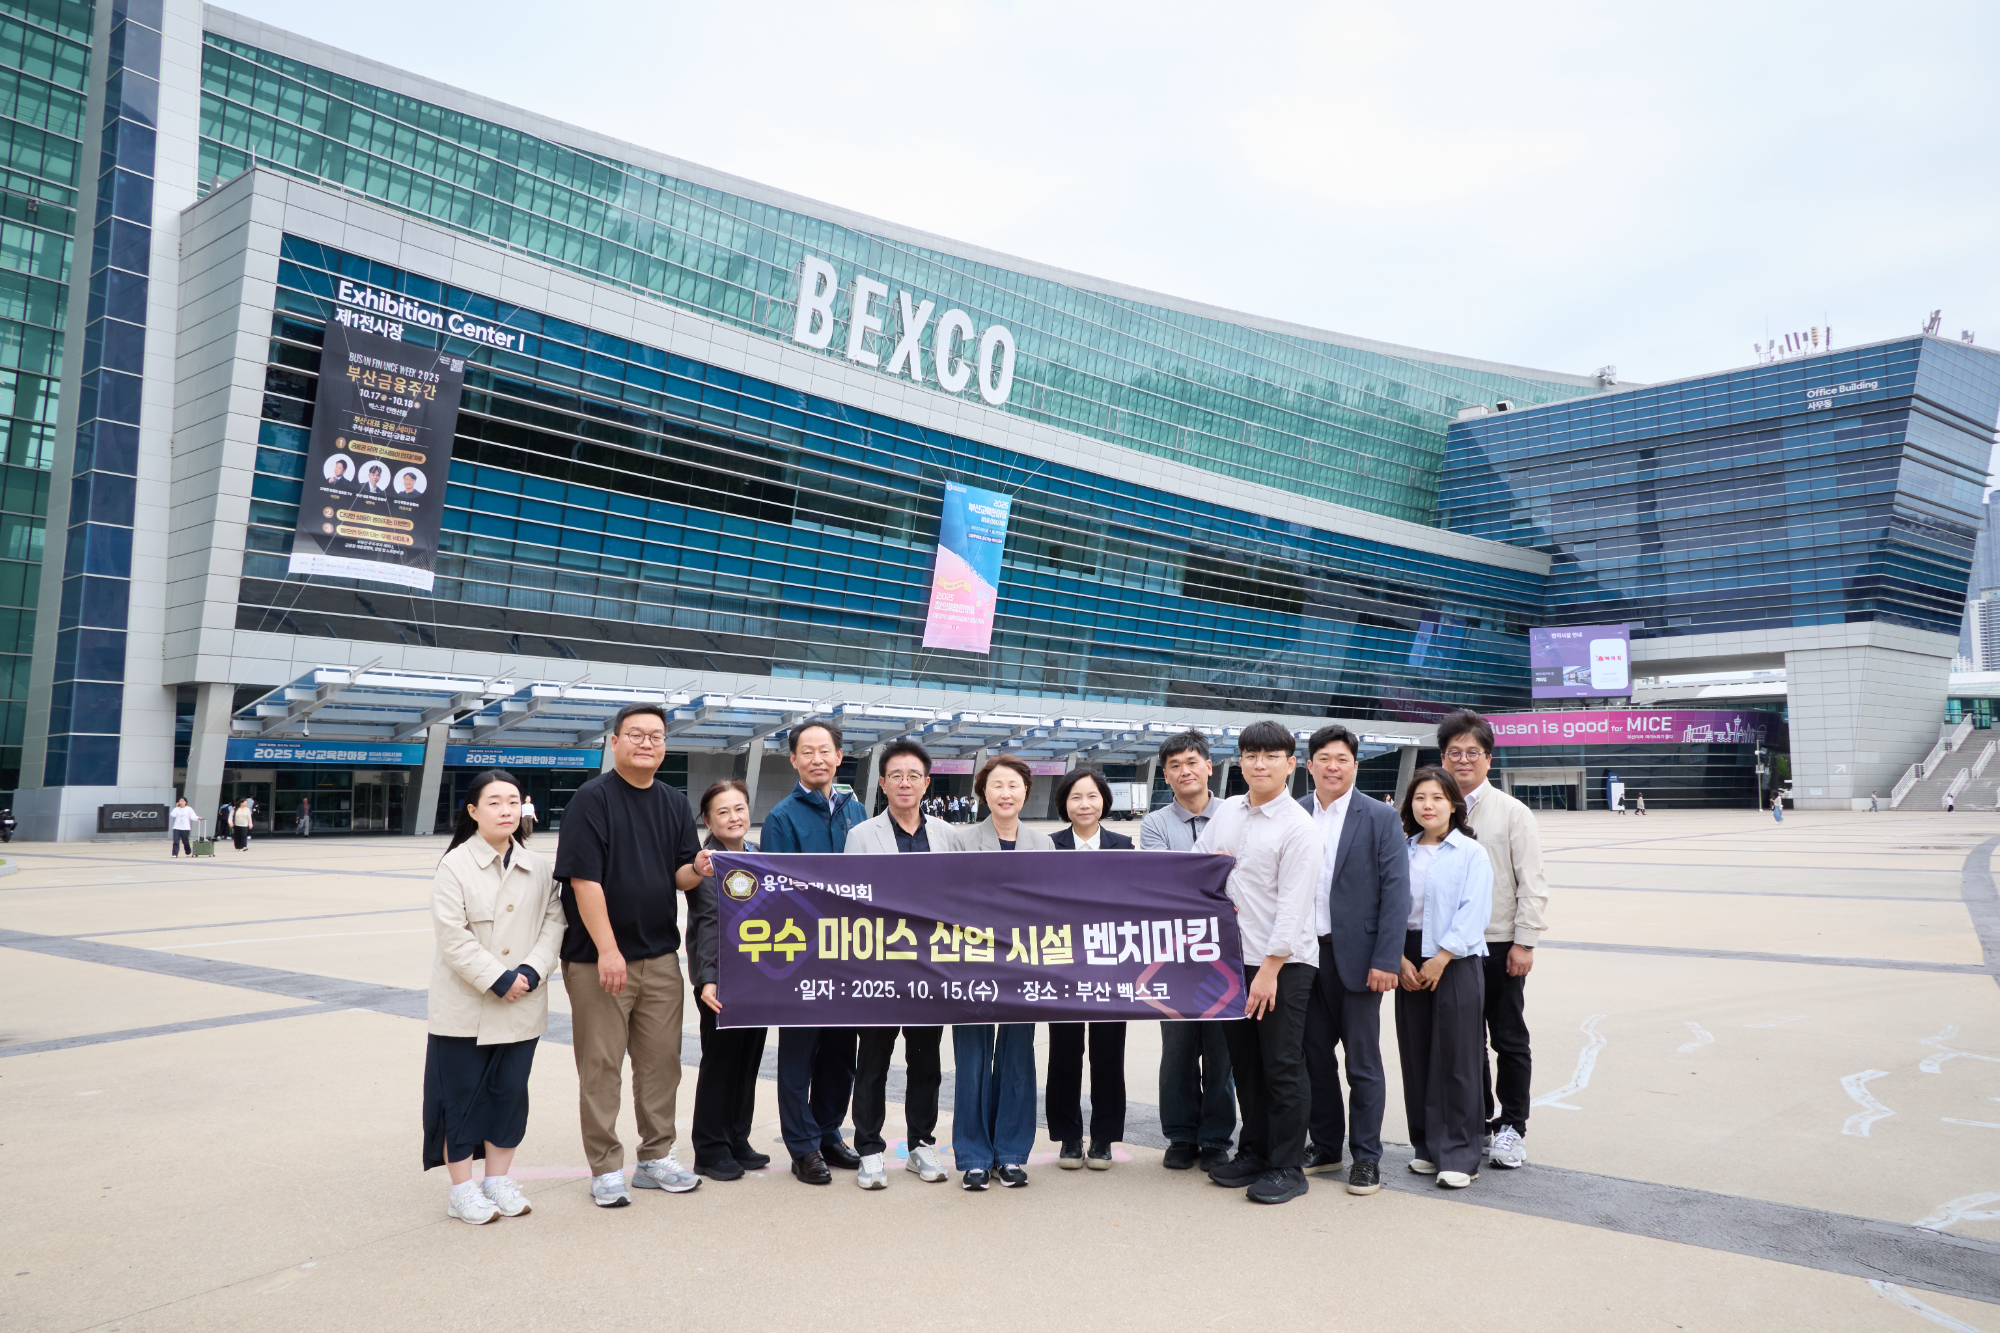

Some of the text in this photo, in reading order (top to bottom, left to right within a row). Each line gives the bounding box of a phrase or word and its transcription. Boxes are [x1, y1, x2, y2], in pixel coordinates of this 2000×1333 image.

[335, 308, 404, 342] 제1전시장
[338, 280, 444, 328] Exhibition
[448, 314, 516, 349] Center
[793, 254, 1016, 405] BEXCO
[349, 352, 440, 383] BUSAN FINANCE WEEK 2025
[346, 365, 436, 400] 부산금융주간
[1806, 380, 1878, 398] Office Building
[1808, 399, 1832, 410] 사무동
[994, 500, 1009, 509] 2025
[1542, 720, 1558, 734] is
[1563, 719, 1608, 737] good
[1627, 716, 1672, 732] MICE
[254, 748, 292, 759] 2025
[294, 750, 367, 760] 부산교육한마당
[466, 754, 556, 765] 2025 부산교육한마당
[112, 810, 158, 819] BEXCO
[738, 916, 1221, 966] 우수 마이스 산업 시설 벤치마킹
[851, 980, 901, 999] 2025.
[907, 980, 934, 1000] 10.
[941, 980, 998, 1002] 15.(수)
[1075, 981, 1111, 1002] 부산
[1117, 982, 1171, 1002] 벡스코
